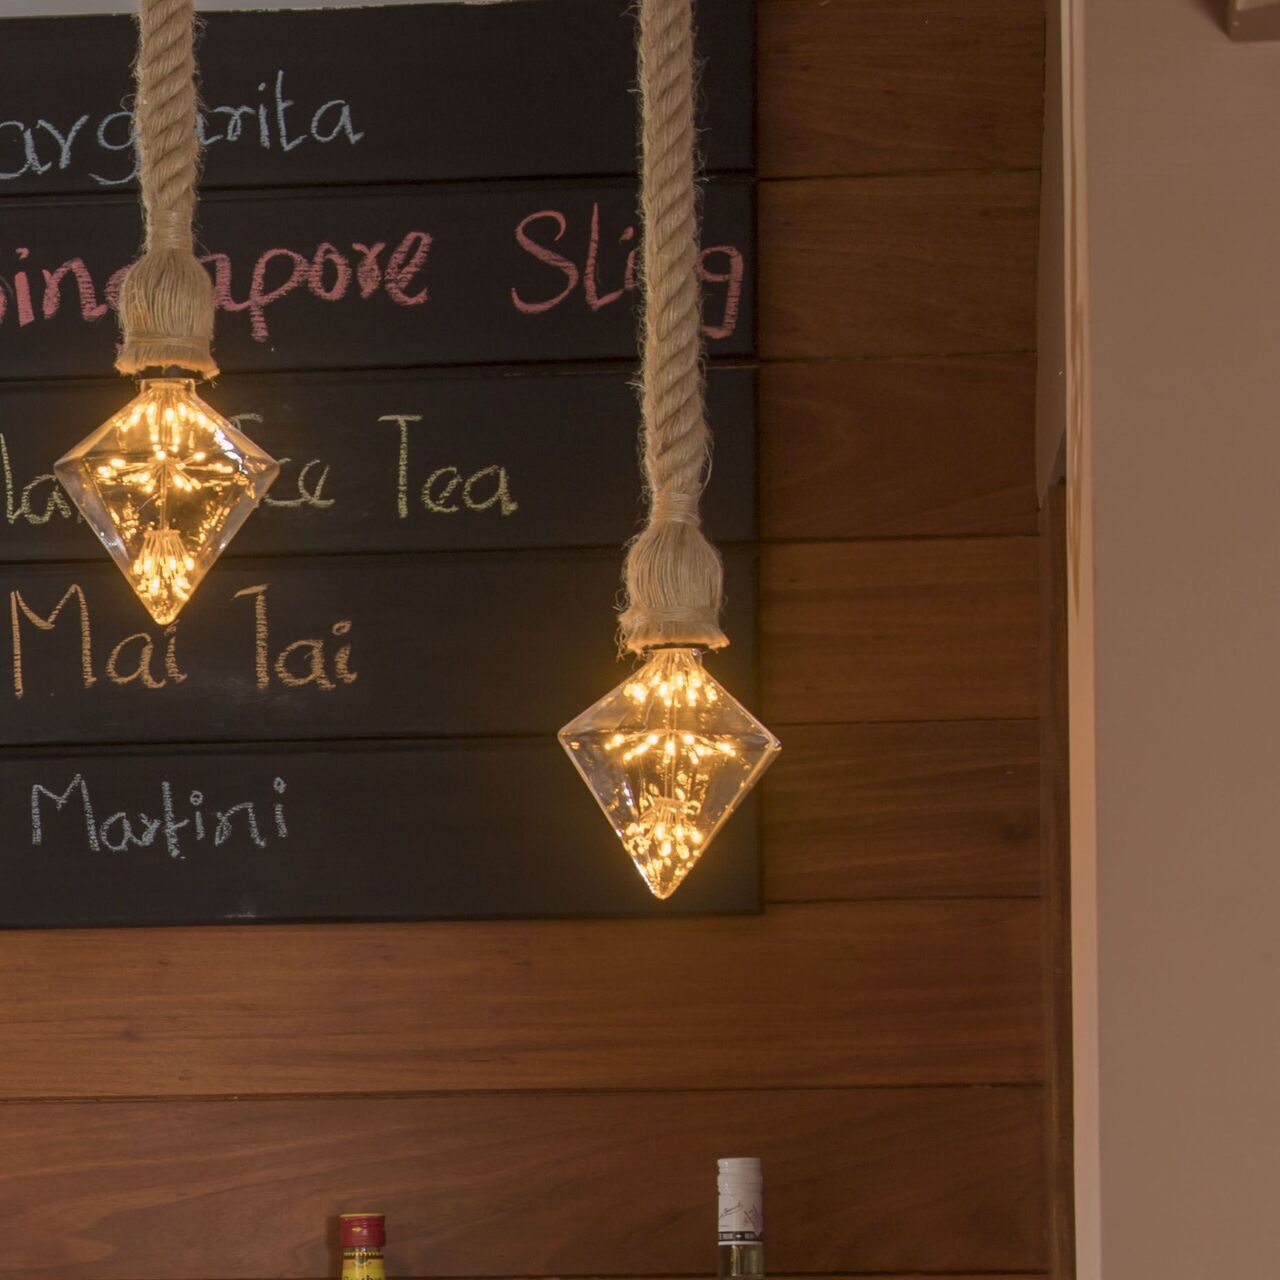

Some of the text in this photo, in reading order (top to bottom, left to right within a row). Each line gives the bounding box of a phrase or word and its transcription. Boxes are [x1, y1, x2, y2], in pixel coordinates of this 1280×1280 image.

[511, 202, 744, 340] Slig
[377, 414, 520, 518] Tea
[10, 584, 359, 698] Mai Tai
[30, 773, 288, 860] Martini
